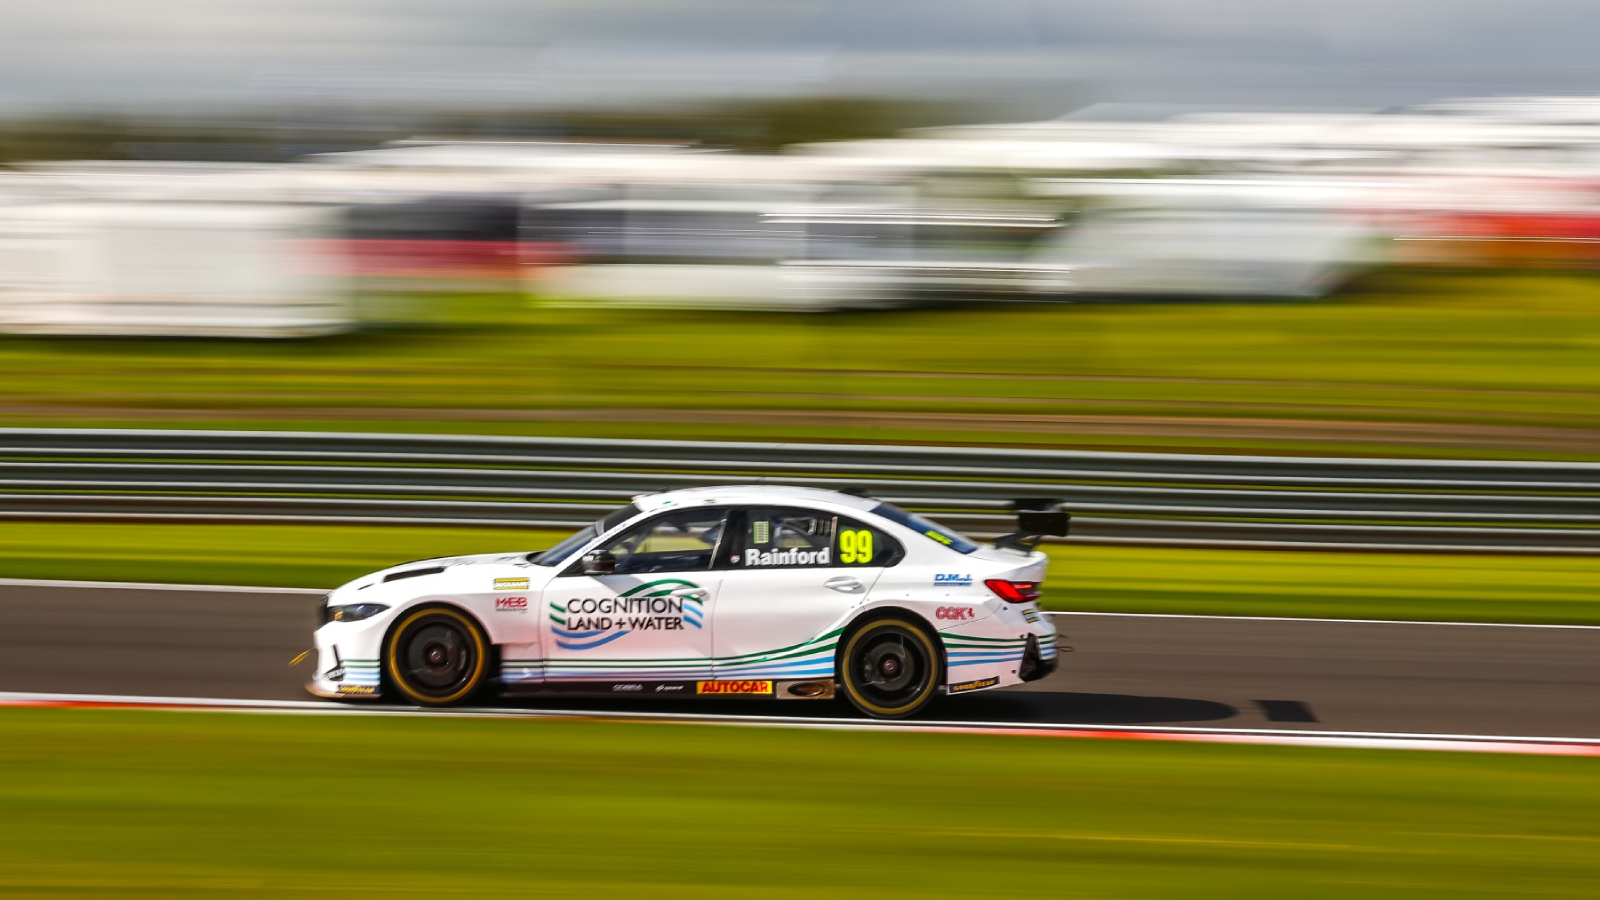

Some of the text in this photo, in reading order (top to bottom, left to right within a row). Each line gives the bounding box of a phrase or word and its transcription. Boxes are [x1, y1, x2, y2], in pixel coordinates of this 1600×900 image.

[840, 529, 873, 564] 99
[744, 547, 831, 567] Rainford
[566, 597, 684, 614] COGNITION
[567, 616, 613, 631] LAND
[628, 616, 685, 631] WATER
[702, 680, 769, 693] AUTOCAR
